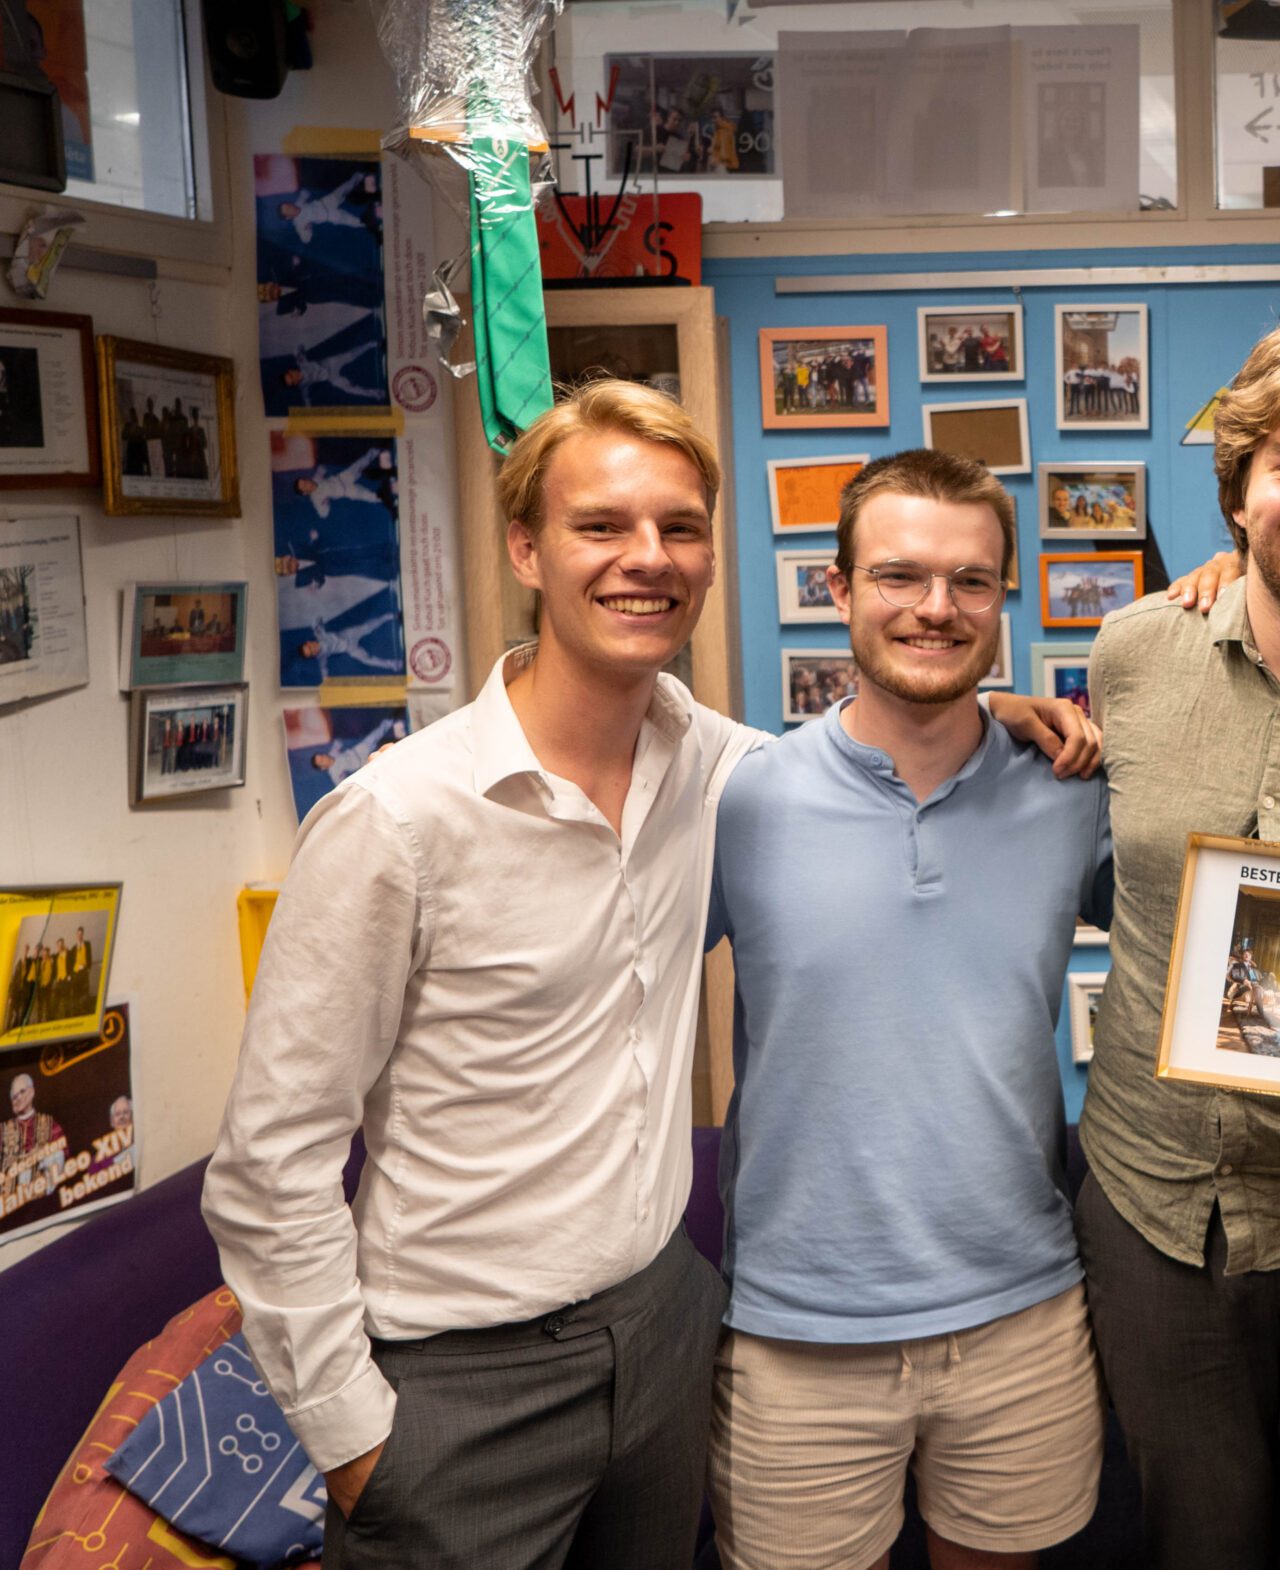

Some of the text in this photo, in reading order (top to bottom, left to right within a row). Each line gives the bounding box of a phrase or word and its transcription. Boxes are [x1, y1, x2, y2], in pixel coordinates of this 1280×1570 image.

[51, 1150, 92, 1185] Leo
[92, 1124, 134, 1163] XIV
[58, 1154, 132, 1208] bekend
